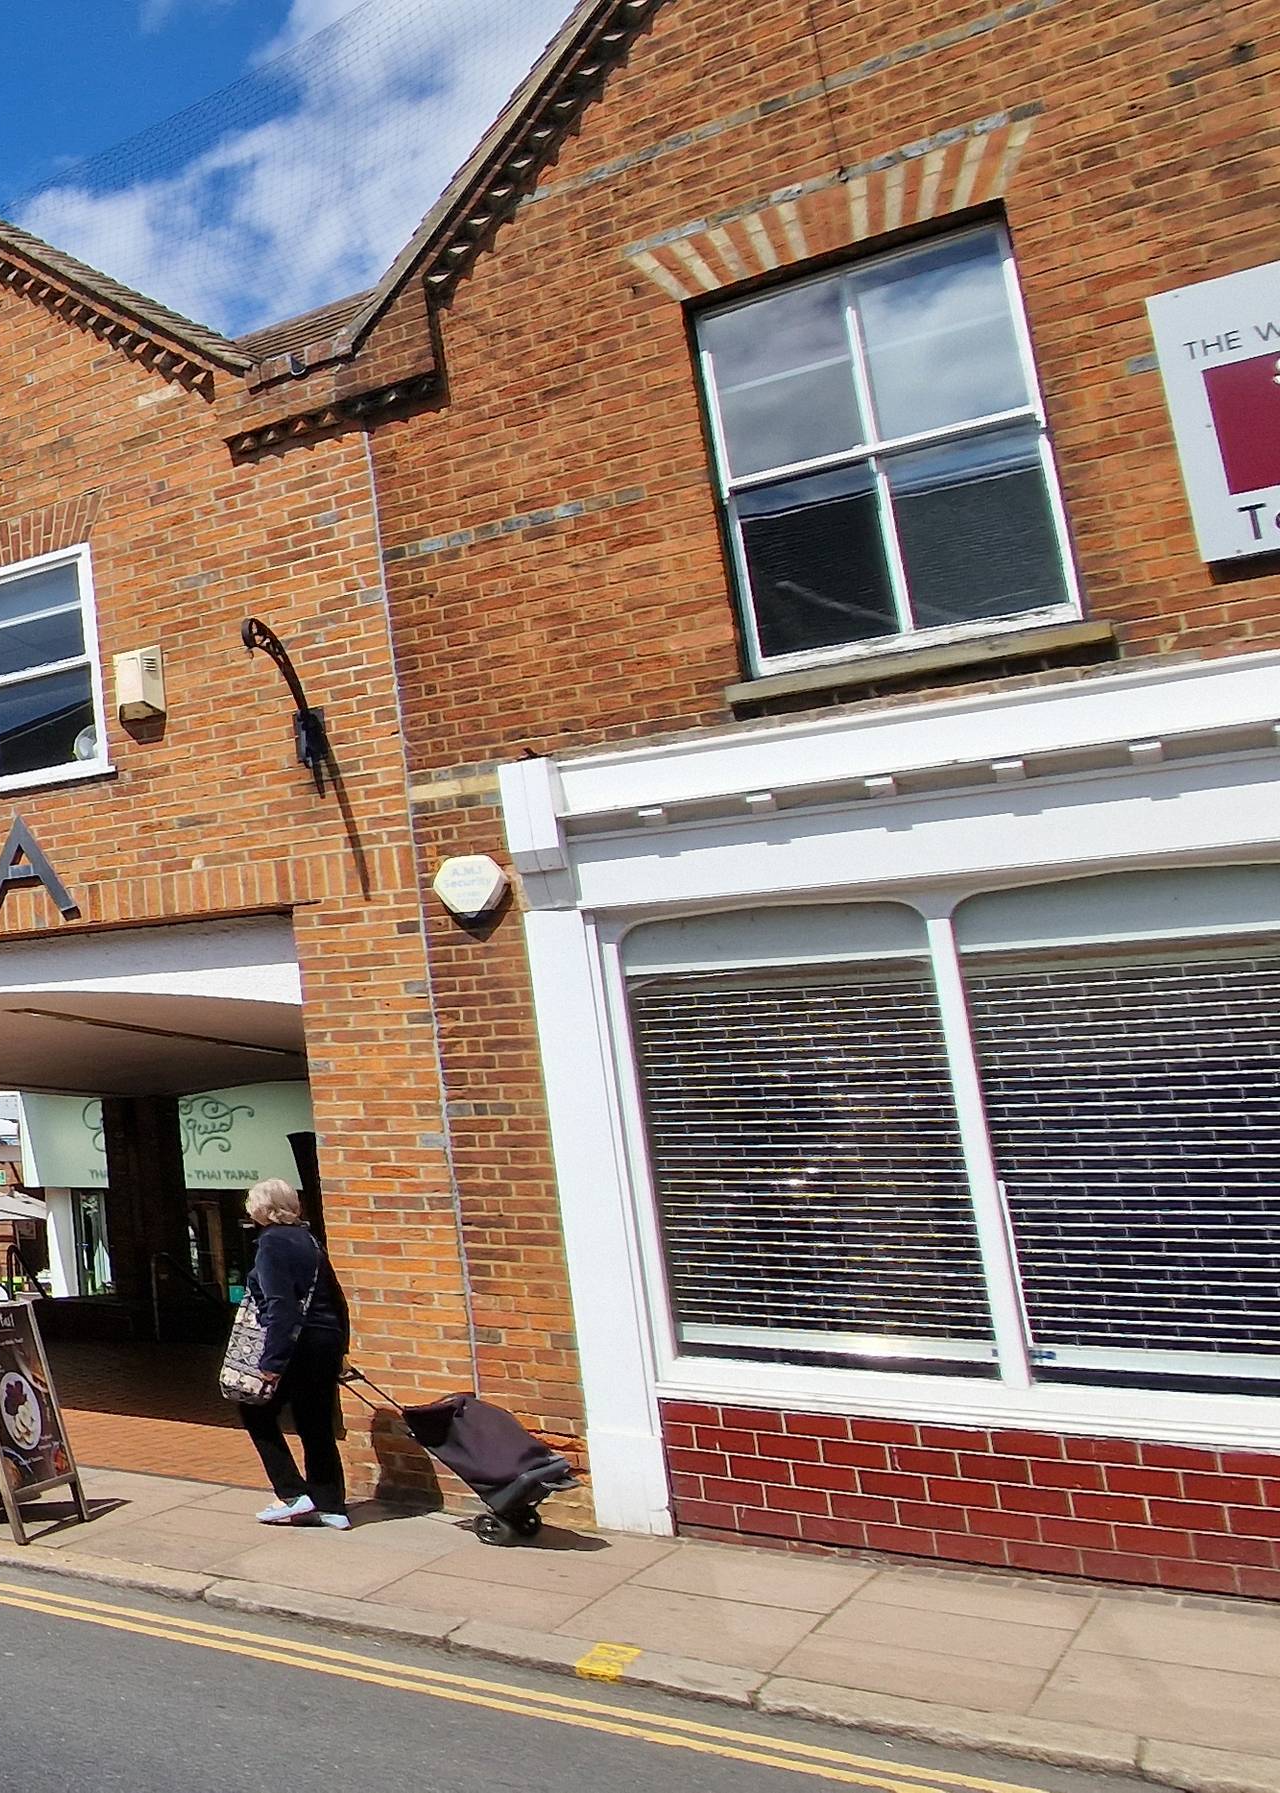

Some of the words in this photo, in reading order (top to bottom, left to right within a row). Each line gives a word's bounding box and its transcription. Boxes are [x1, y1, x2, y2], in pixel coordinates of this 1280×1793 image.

[1183, 330, 1243, 360] THE
[194, 1171, 222, 1181] THAI
[223, 1171, 259, 1181] TAPAS
